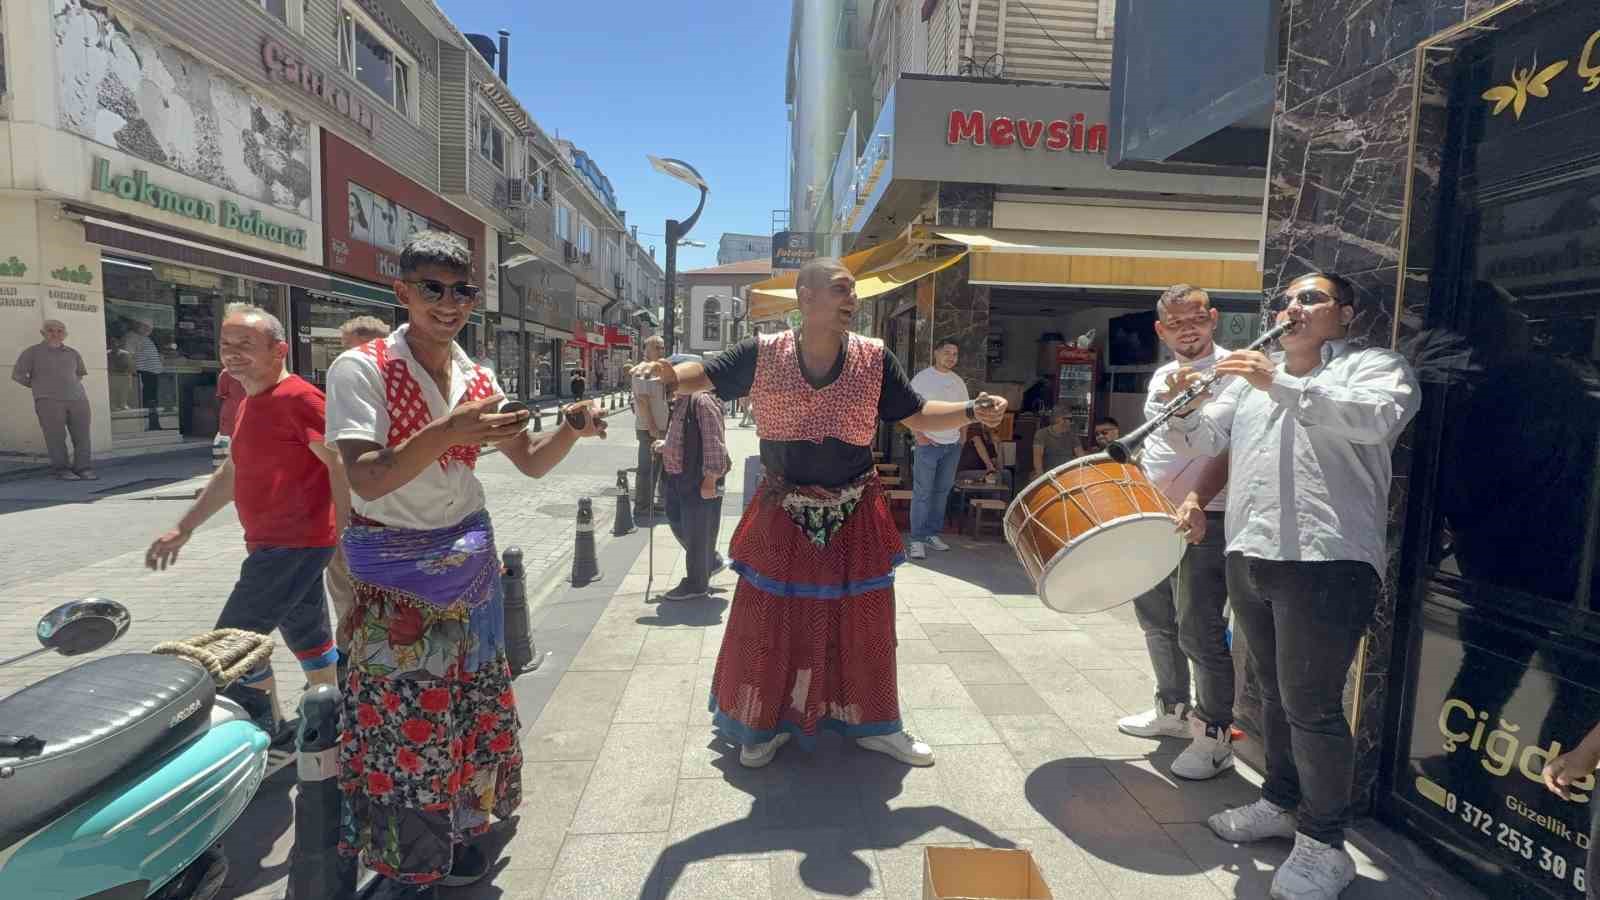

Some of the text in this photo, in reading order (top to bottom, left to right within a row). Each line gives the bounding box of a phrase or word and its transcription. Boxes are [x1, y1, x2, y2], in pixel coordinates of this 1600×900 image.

[99, 158, 307, 249] Lokman Baharat
[1445, 792, 1457, 814] 0
[1461, 800, 1493, 837] 372
[1496, 823, 1535, 860] 253
[1539, 846, 1567, 880] 30
[1505, 795, 1572, 841] Güzellik
